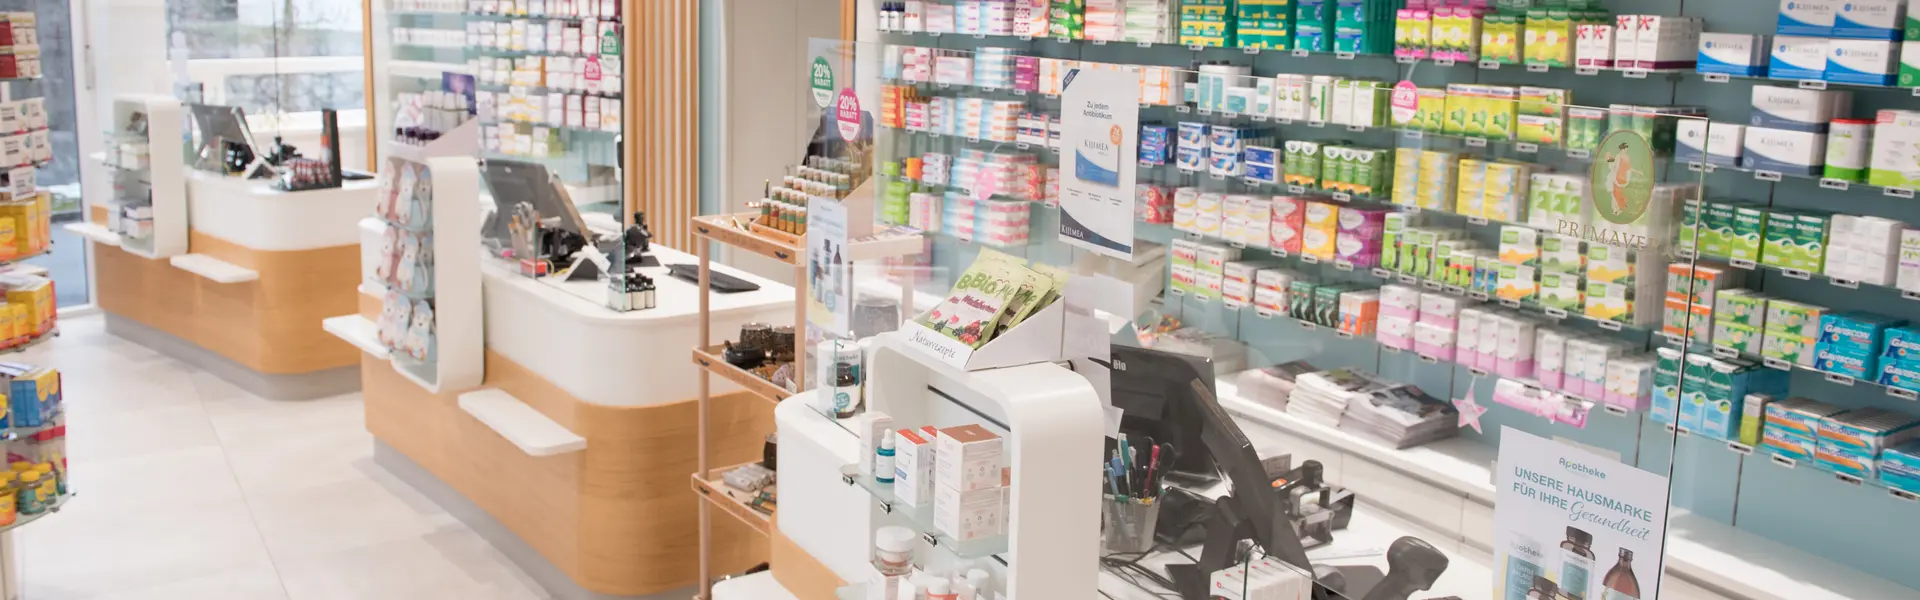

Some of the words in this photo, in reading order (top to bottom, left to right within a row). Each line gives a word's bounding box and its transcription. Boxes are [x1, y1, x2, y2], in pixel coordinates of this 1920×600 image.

[814, 63, 831, 79] 20%
[840, 95, 857, 111] 20%
[1087, 101, 1093, 109] Zu
[1094, 102, 1109, 111] jedem
[1083, 109, 1112, 120] Antibiotikum
[1084, 139, 1109, 152] KIJIMEA
[1061, 223, 1084, 239] KIJIMEA
[1558, 457, 1606, 479] Apotheke
[1515, 466, 1564, 492] UNSERE
[1567, 484, 1652, 522] HAUSMARKE
[1513, 481, 1536, 498] FÜR
[1539, 491, 1568, 511] IHRE
[1568, 500, 1650, 542] Gesundheit
